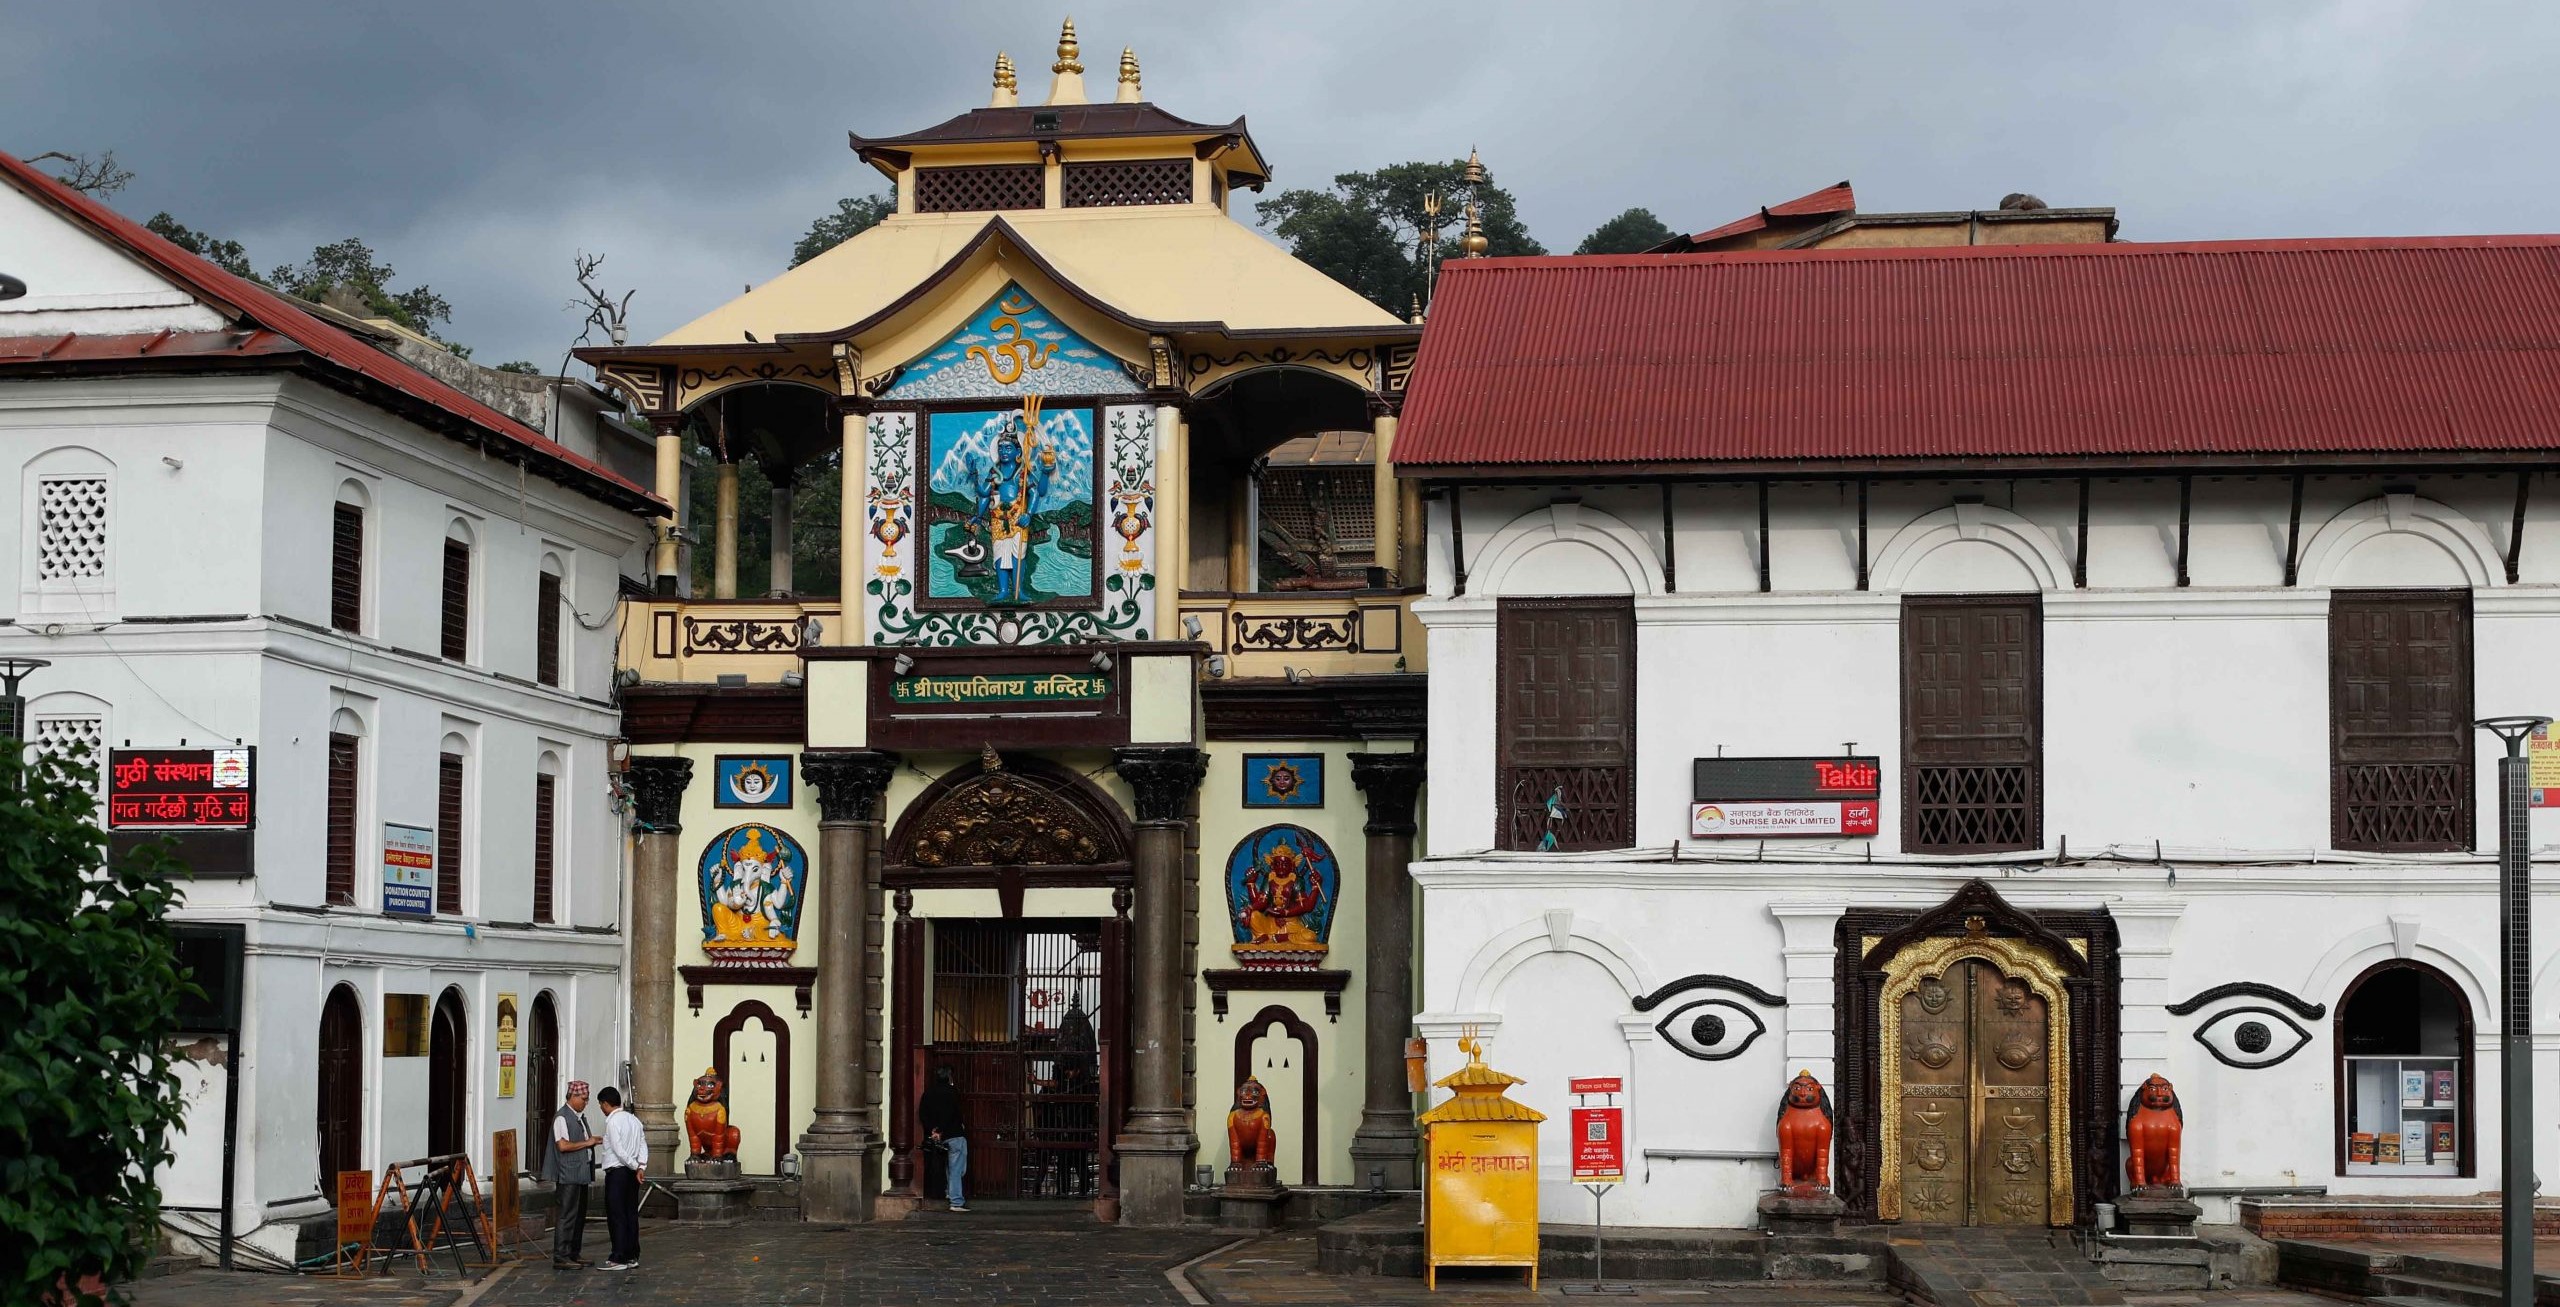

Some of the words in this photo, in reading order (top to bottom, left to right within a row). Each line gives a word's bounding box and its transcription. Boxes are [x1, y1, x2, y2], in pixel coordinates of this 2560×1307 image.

[1033, 674, 1089, 697] मन्दिर
[115, 758, 149, 788] गुठी
[153, 759, 212, 781] संस्थान
[229, 797, 247, 816] सं
[1848, 808, 1870, 818] हामी
[1729, 818, 1768, 826] SUNRISE
[1800, 817, 1836, 825] LIMITED
[385, 887, 408, 897] DONATION
[409, 889, 430, 898] COUNTER
[406, 900, 426, 909] COUNTER)
[1471, 1155, 1529, 1175] दानपात्र
